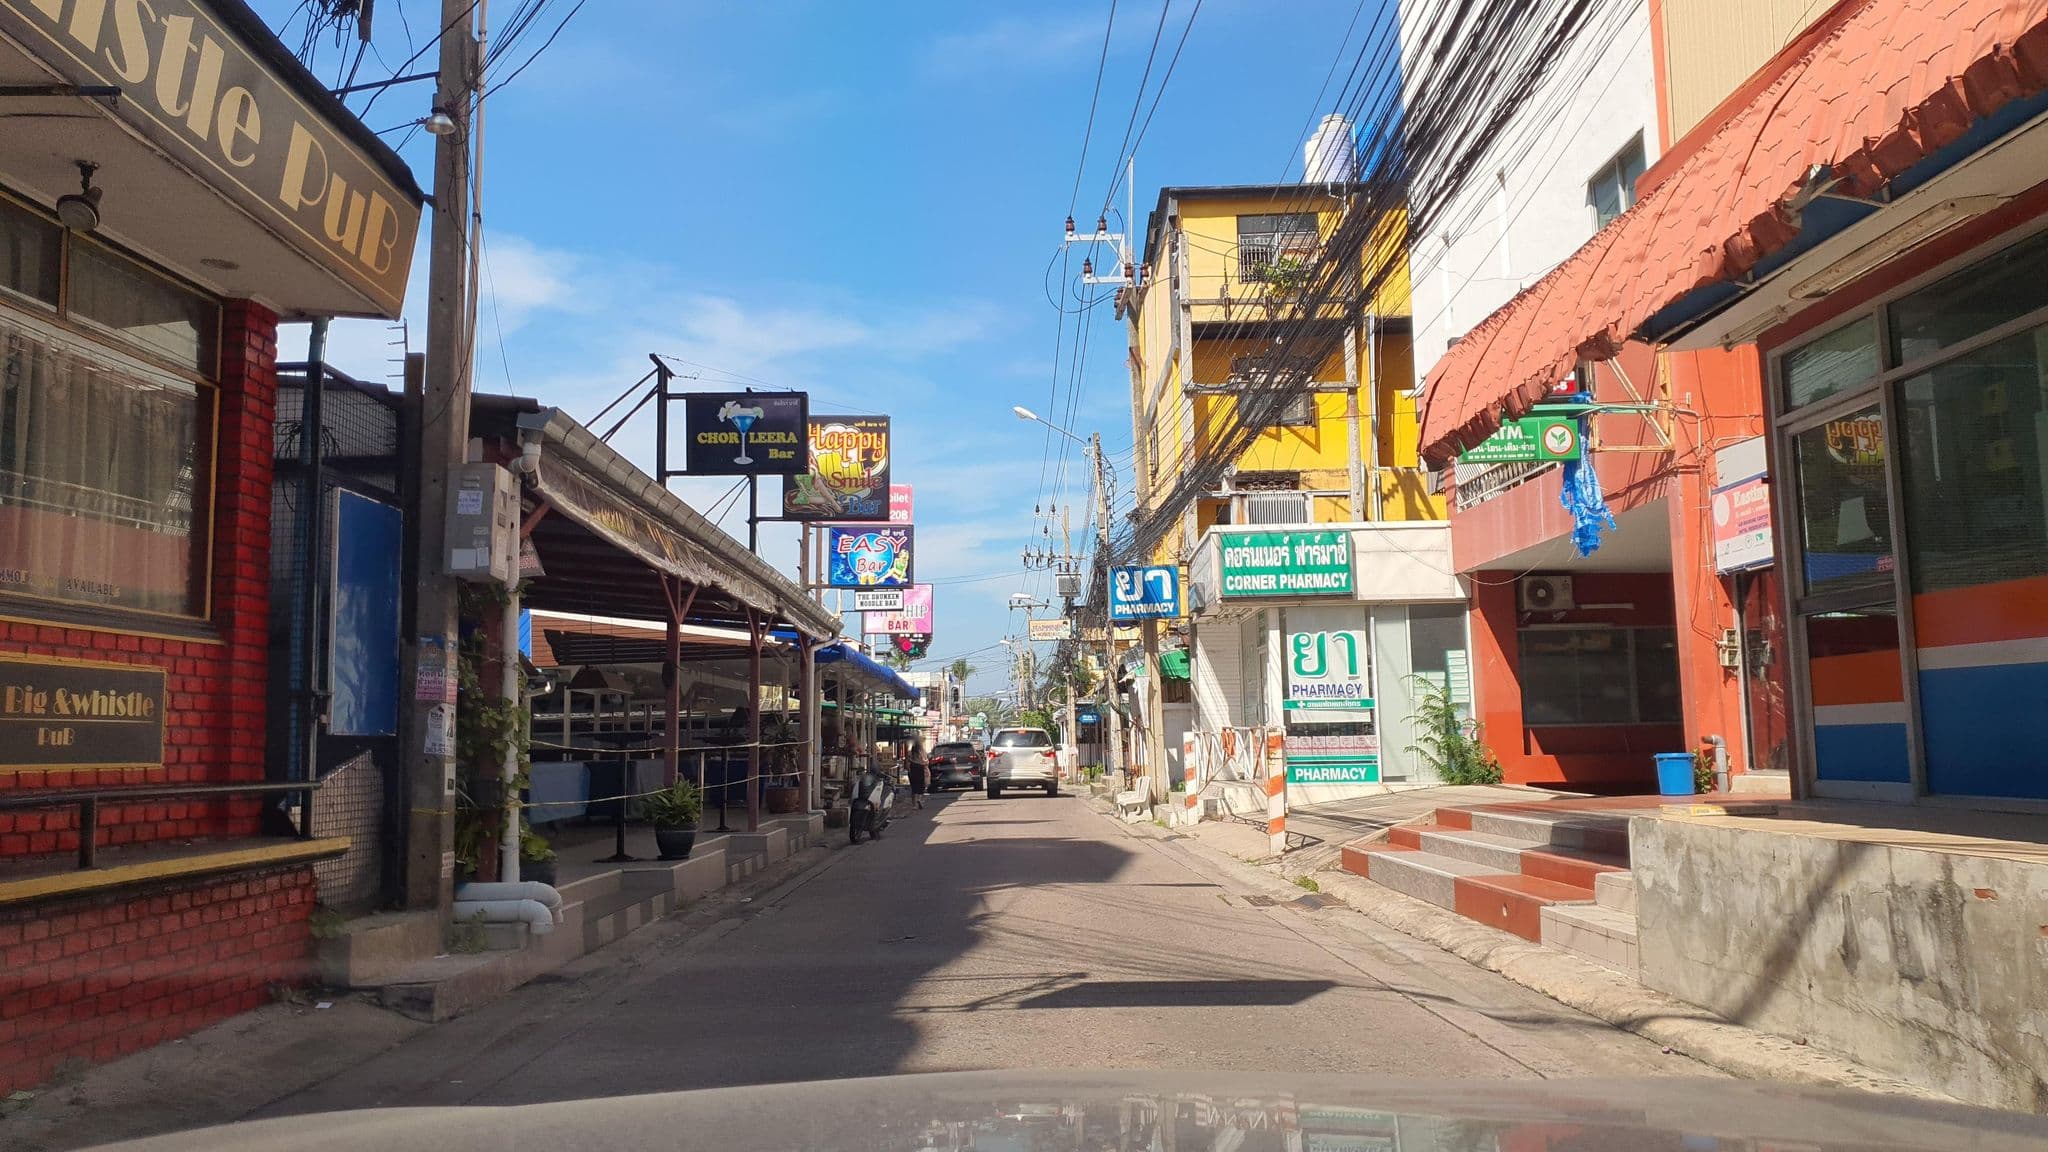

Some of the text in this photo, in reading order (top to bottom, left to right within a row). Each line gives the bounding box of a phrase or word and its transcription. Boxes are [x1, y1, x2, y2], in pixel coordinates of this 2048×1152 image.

[697, 431, 798, 444] CHOR LEERA
[808, 423, 887, 462] Happy
[768, 448, 795, 459] Bar
[828, 468, 883, 489] Smile
[839, 494, 880, 514] Bar
[837, 536, 907, 553] EASY
[1225, 536, 1290, 568] คอร์นเนอร์
[856, 558, 887, 573] Bar
[1115, 569, 1173, 602] ยา
[1226, 572, 1348, 590] CORNER PHARMACY
[1115, 602, 1174, 615] PHARMACY
[888, 621, 909, 630] BAR
[1292, 631, 1359, 677] ยา
[1292, 684, 1362, 696] PHARMACY
[5, 685, 48, 715] Big
[1295, 768, 1367, 780] PHARMACY
